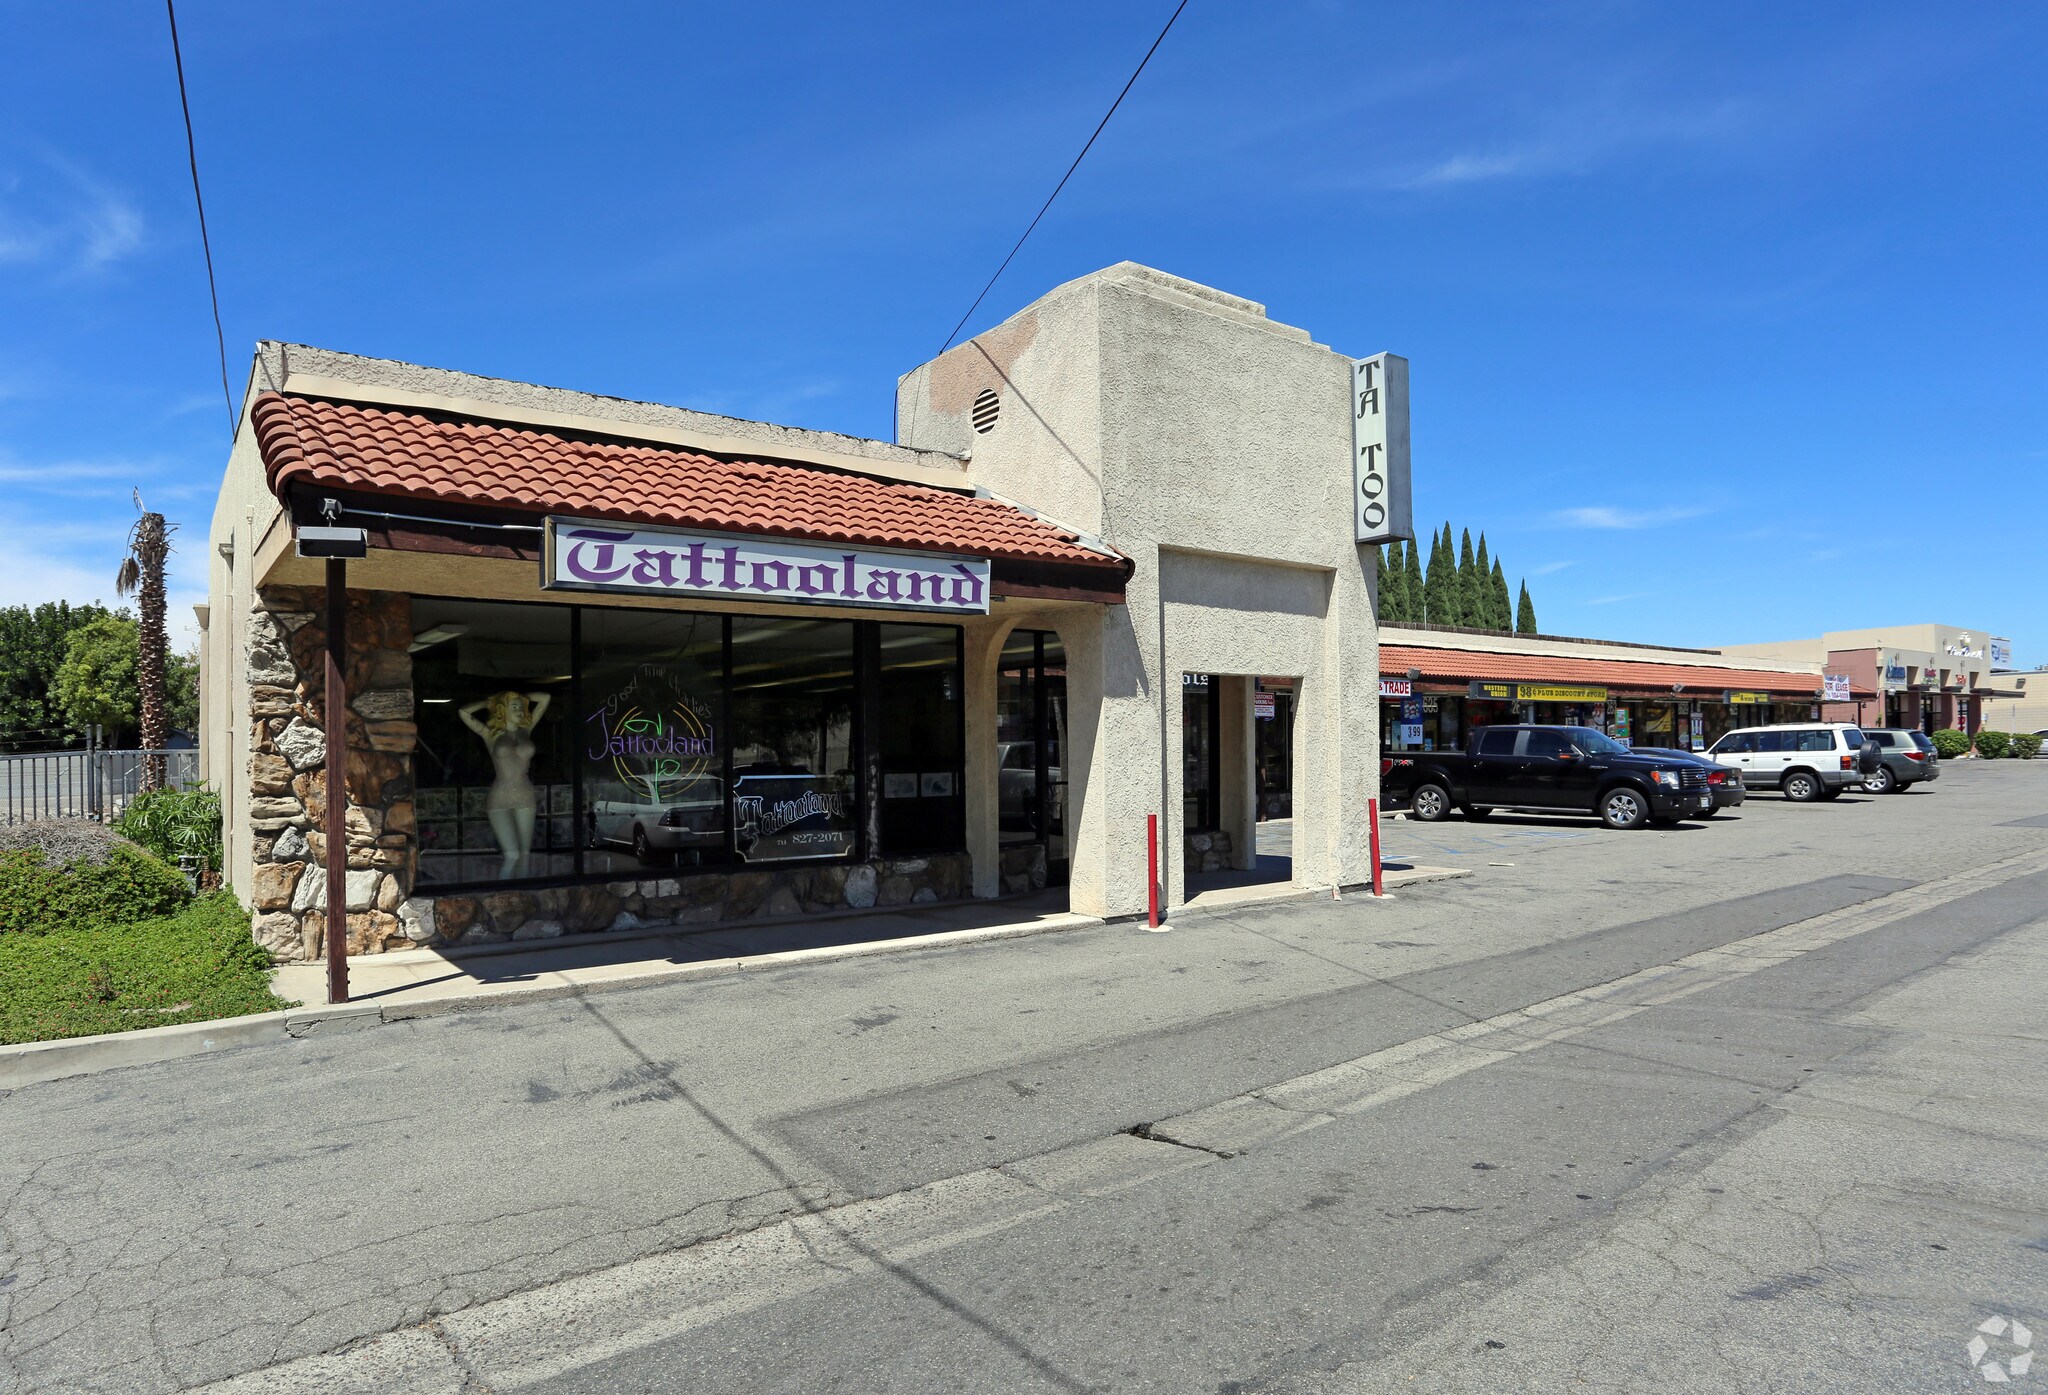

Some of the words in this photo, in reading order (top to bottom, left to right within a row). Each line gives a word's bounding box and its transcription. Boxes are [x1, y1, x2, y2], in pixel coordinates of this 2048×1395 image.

[566, 529, 986, 607] Tattooland
[1384, 681, 1410, 695] TRADE
[1537, 689, 1554, 697] PLUS
[1554, 689, 1586, 698] DISCOUNT
[1586, 690, 1606, 699] STORE
[585, 705, 716, 761] Tattooland
[792, 831, 844, 844] 827-2071
